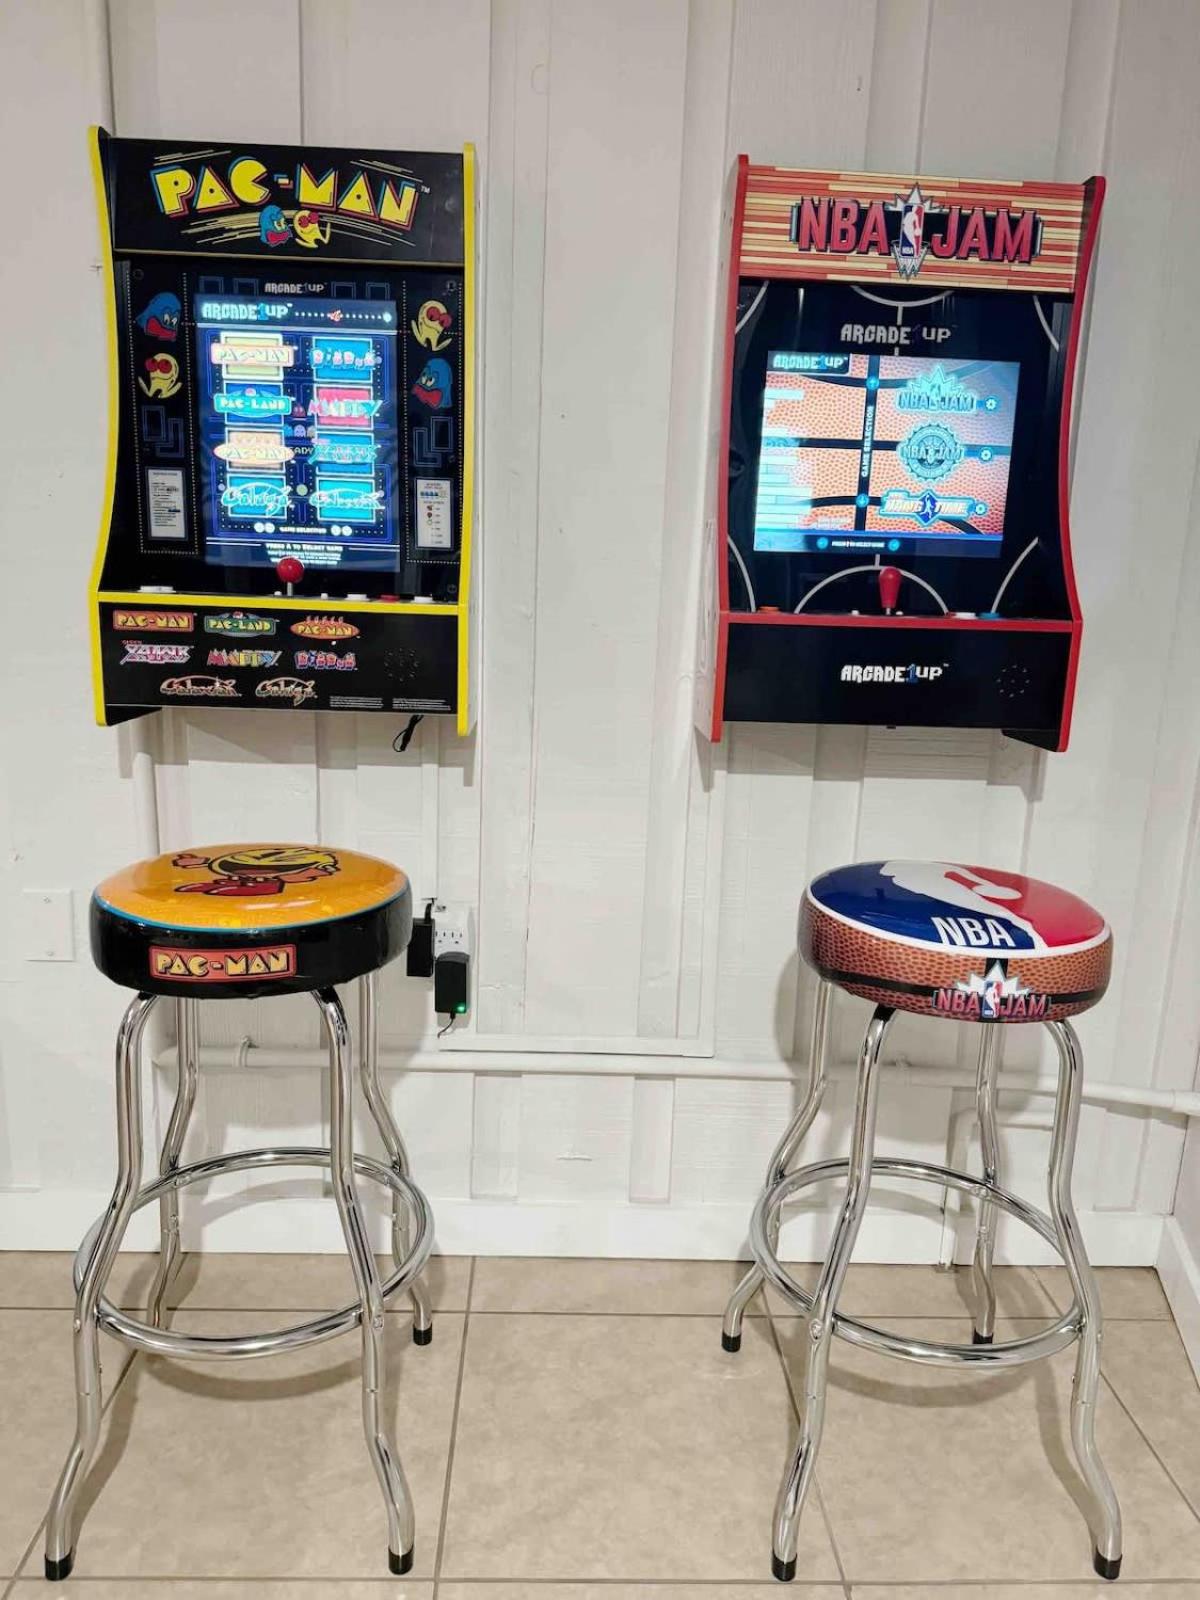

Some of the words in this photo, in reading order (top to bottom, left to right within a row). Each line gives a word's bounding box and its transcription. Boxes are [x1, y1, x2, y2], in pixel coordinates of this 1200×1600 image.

[151, 156, 419, 231] PAC-MAN
[798, 197, 892, 256] NBA
[931, 205, 1036, 264] JAM
[202, 303, 289, 321] ARCADE1UP
[220, 398, 286, 411] PAC-LAND
[940, 395, 974, 412] JAM
[118, 613, 190, 629] PAC-MAN
[209, 619, 271, 631] PAC-LAND
[297, 624, 353, 636] PAC-MAN
[840, 663, 943, 683] ARCADE1UP
[931, 917, 1016, 948] NBA
[156, 951, 289, 977] PAC-MAN
[937, 988, 980, 1015] NBA
[1000, 993, 1047, 1017] JAM
